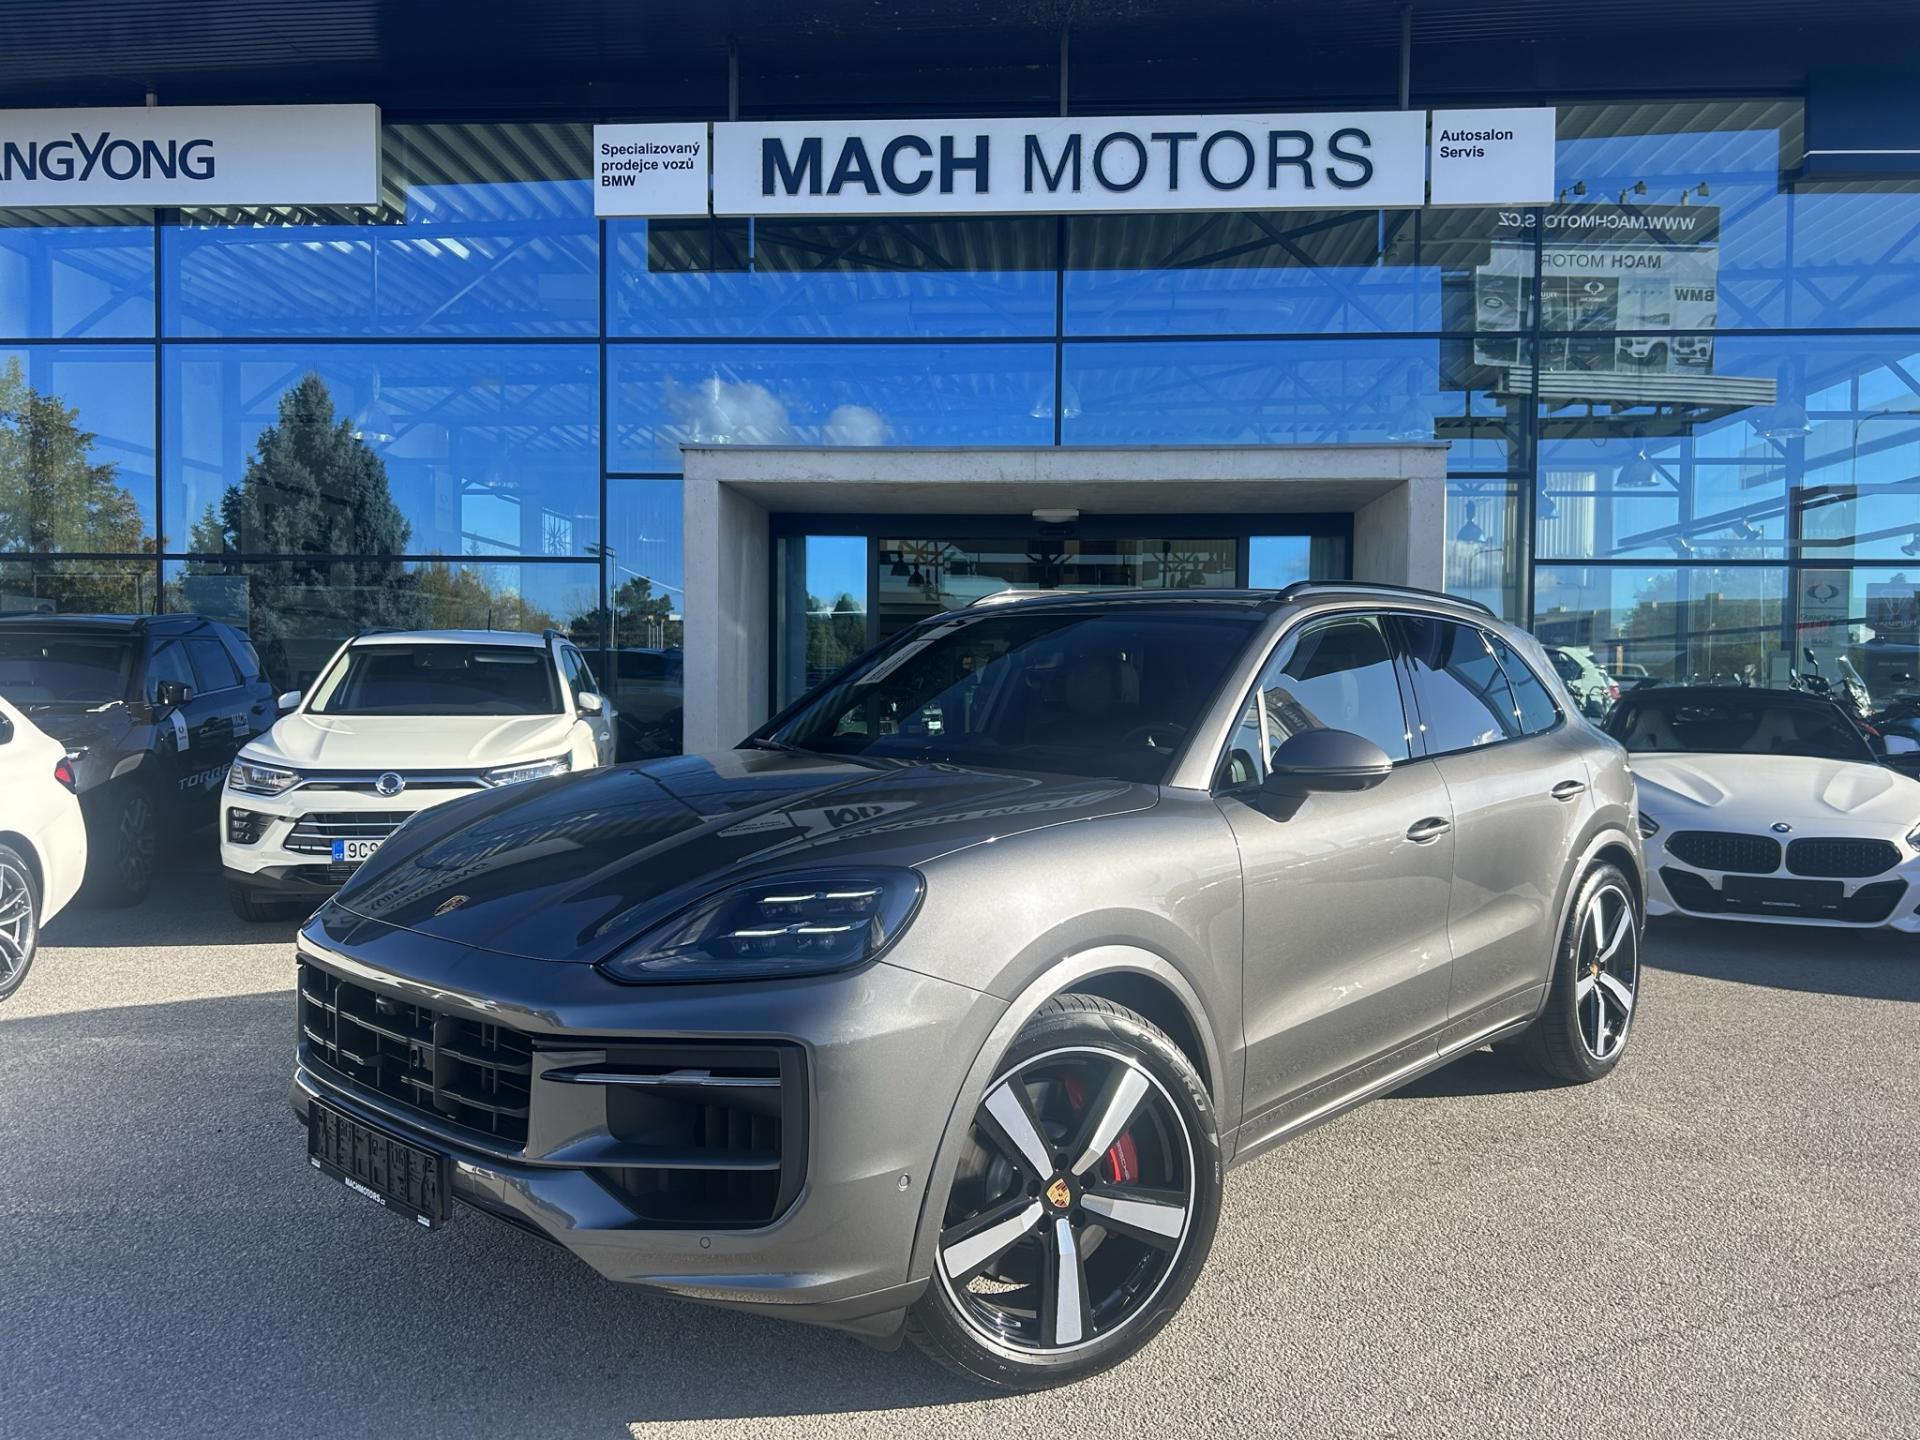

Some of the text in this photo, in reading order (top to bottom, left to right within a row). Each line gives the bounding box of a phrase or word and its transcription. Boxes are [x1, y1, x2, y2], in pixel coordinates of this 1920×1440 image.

[1440, 129, 1513, 142] Autosalon
[0, 132, 216, 182] NGYONG
[601, 141, 700, 158] Specializovaný
[1440, 145, 1485, 158] Servis
[601, 157, 694, 174] prodejce vozů
[762, 128, 1374, 197] MACH MOTORS
[601, 175, 636, 187] BMW
[178, 763, 231, 790] TORRE
